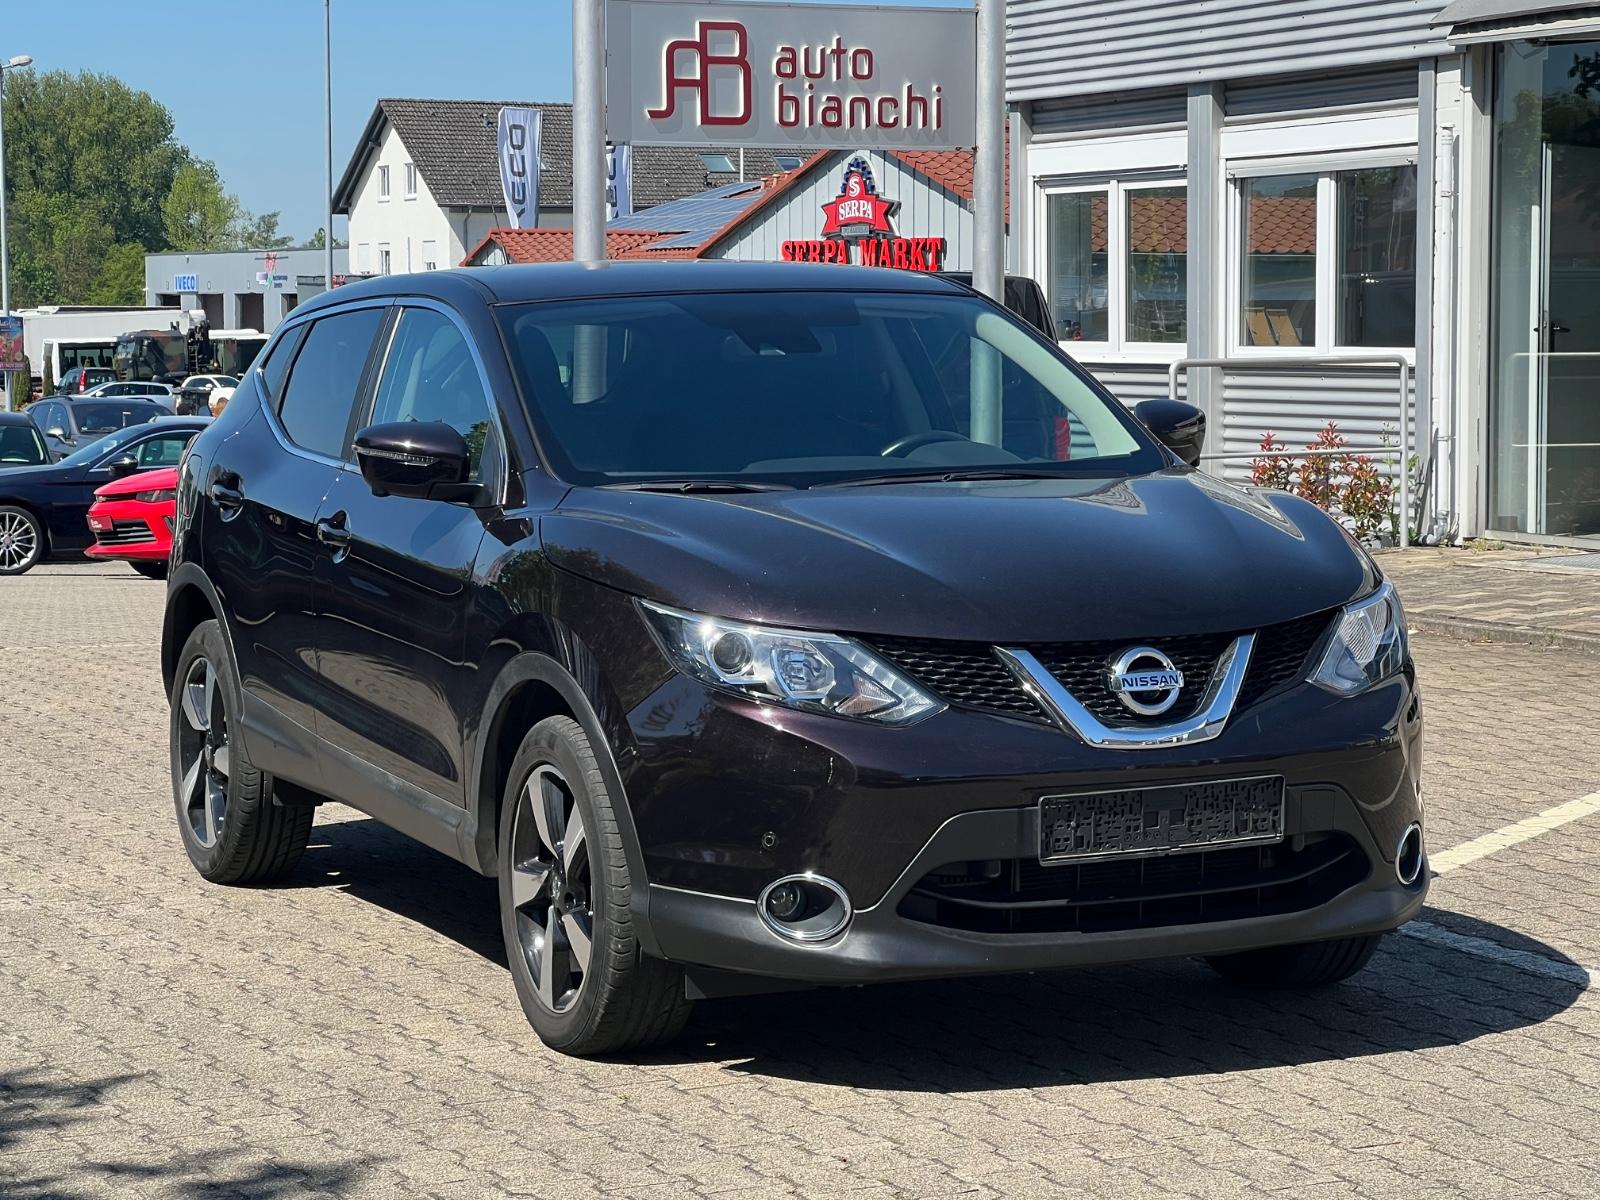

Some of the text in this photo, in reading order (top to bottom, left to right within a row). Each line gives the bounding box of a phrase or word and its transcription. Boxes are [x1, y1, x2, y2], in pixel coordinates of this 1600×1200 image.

[774, 36, 874, 80] auto
[777, 83, 942, 129] bianchi
[838, 199, 873, 221] SERPA
[781, 237, 941, 273] SERPA MARKT
[175, 275, 195, 290] IVECO
[1121, 674, 1179, 688] NISSAN
